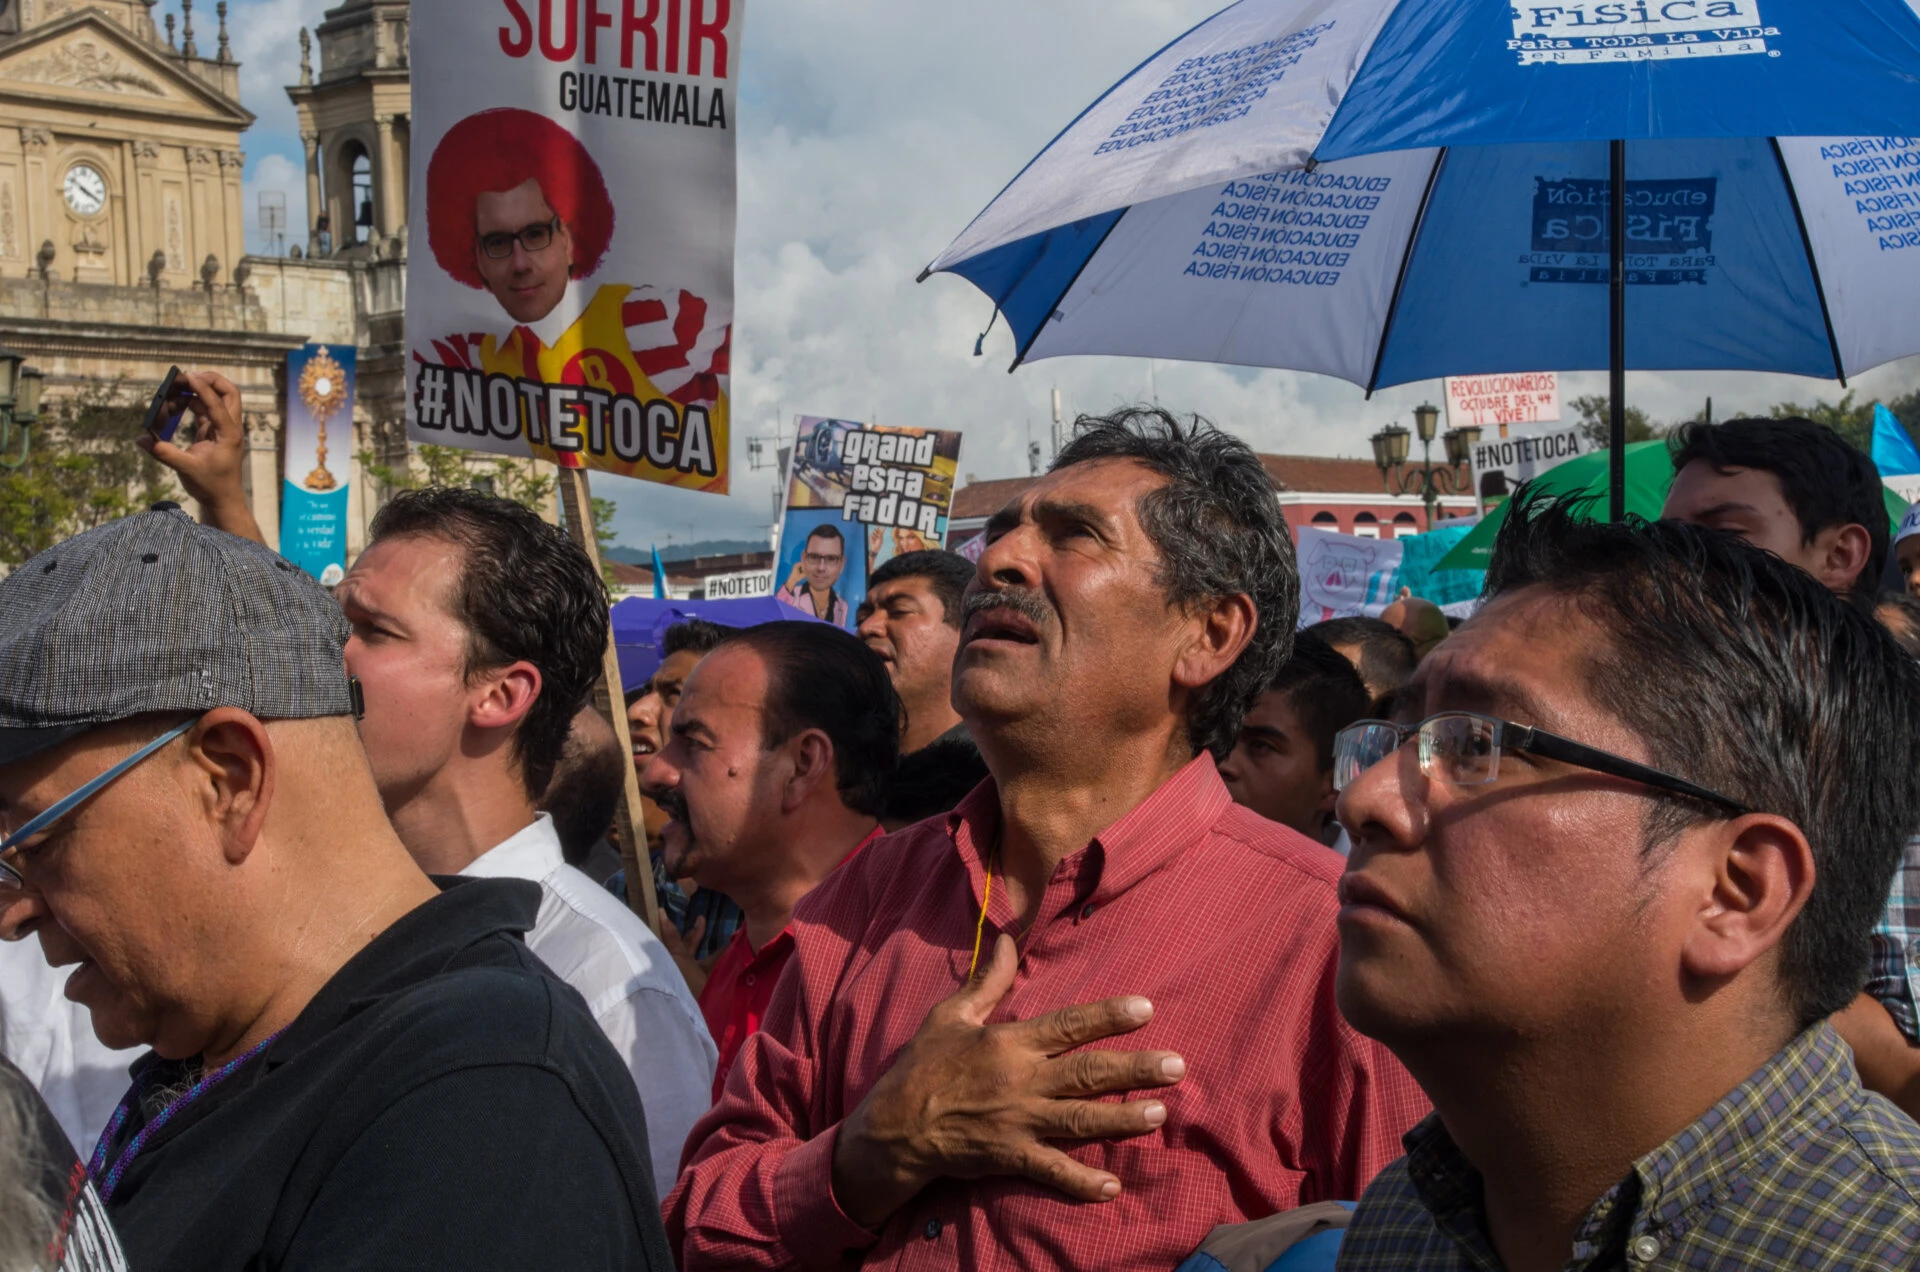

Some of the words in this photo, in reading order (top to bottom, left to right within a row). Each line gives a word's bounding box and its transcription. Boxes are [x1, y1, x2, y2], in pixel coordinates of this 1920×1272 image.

[559, 71, 727, 129] GUATEMALA
[1451, 375, 1555, 397] REVOLUCIONARIOS
[1460, 395, 1509, 411] OCTUBRE
[1514, 395, 1534, 406] DEL
[417, 364, 716, 476] #NOTETOCA
[1476, 432, 1580, 469] #NOTETOCA
